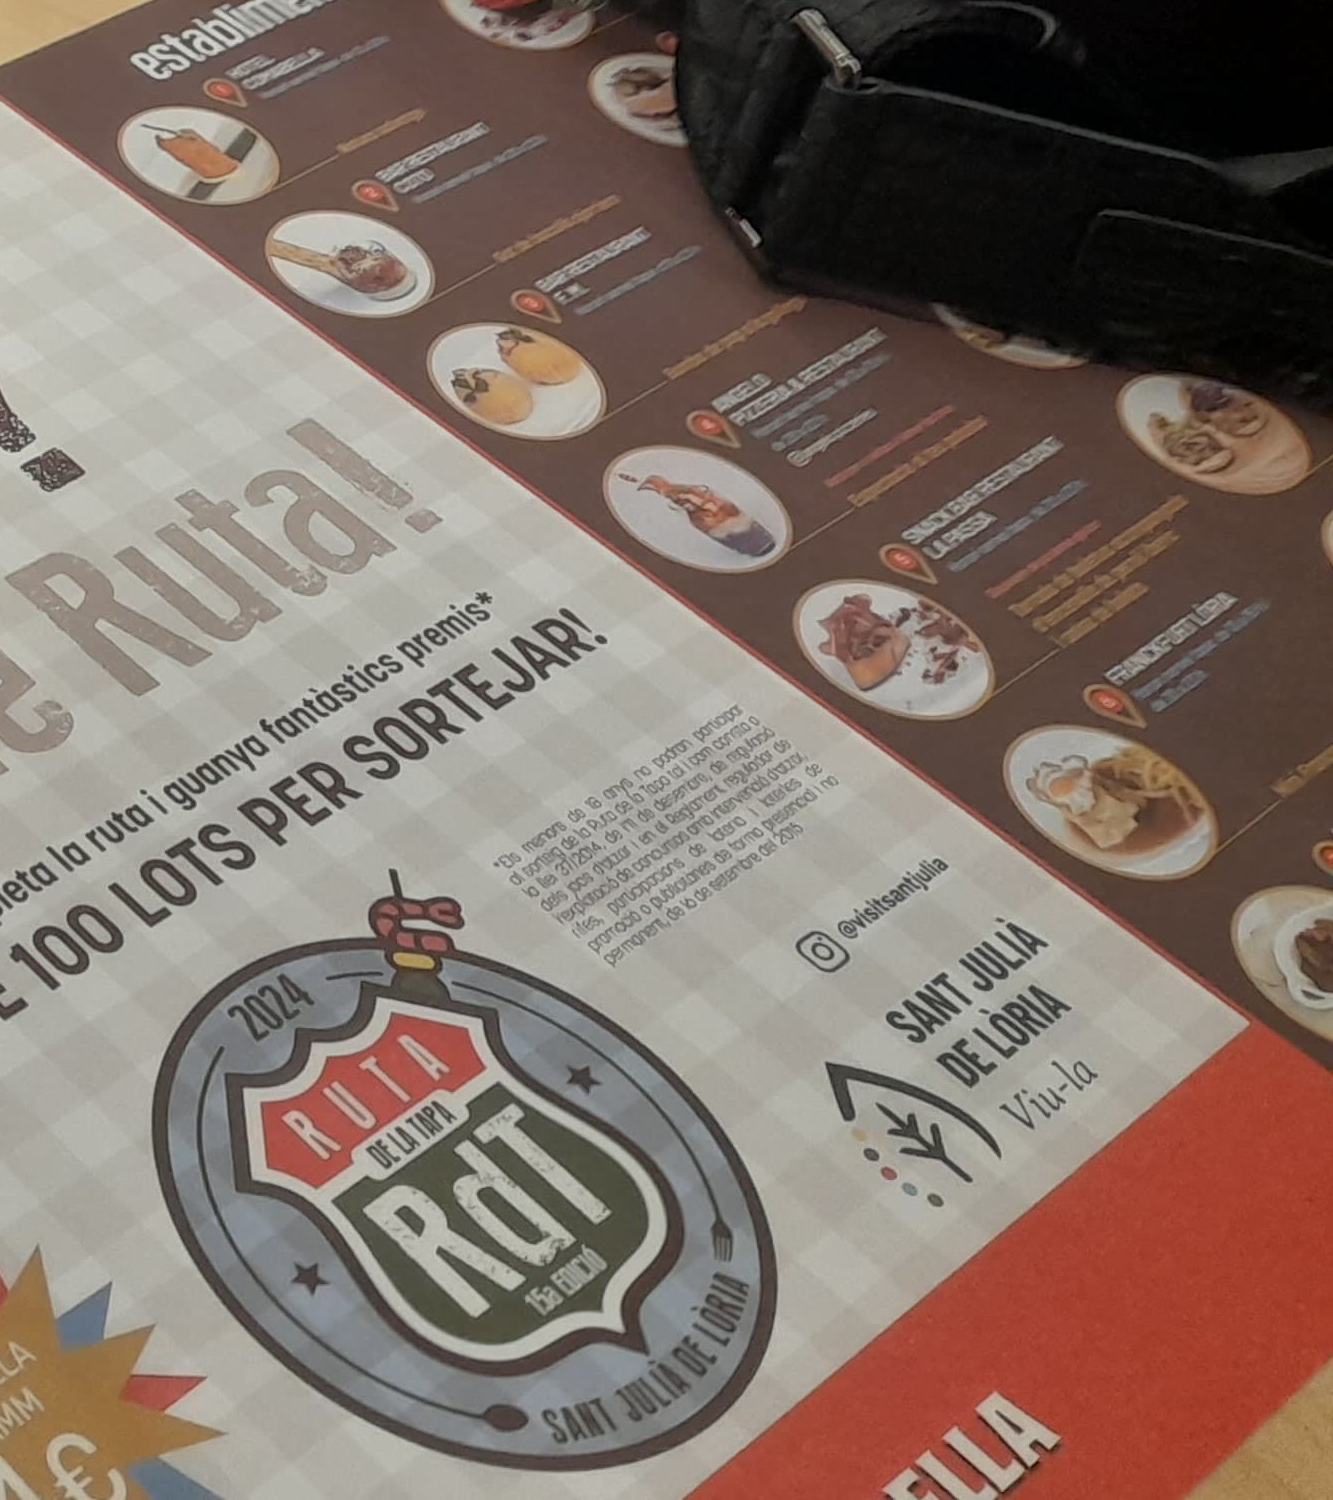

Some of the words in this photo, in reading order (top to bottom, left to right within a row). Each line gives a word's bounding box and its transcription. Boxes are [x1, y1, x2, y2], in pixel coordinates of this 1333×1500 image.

[0, 412, 449, 699] Ruta!
[3, 898, 131, 993] 100
[105, 816, 267, 931] LOTS
[234, 755, 364, 847] PER
[334, 604, 610, 785] SORTEJAR!
[45, 835, 94, 873] la
[77, 798, 160, 857] ruta
[158, 732, 278, 812] guanya
[253, 646, 408, 746] fantàstics
[832, 851, 954, 944] @visitsantjulia
[223, 971, 318, 1043] 2024
[881, 969, 980, 1048] SANT
[942, 911, 1050, 996] JULIÀ
[963, 973, 1073, 1061] LÒRIA
[279, 1029, 452, 1162] RUTA
[934, 1036, 1000, 1089] DE
[998, 1049, 1101, 1134] Viu-la
[364, 1137, 404, 1171] DE
[385, 1123, 423, 1155] LA
[404, 1098, 460, 1142] TAPA
[359, 1100, 626, 1321] RdT
[545, 1242, 610, 1296] EDICIÓ
[692, 1271, 753, 1346] LÒRIA
[609, 1347, 696, 1420] JULIÀ
[670, 1333, 717, 1378] DE
[543, 1396, 621, 1443] SANT
